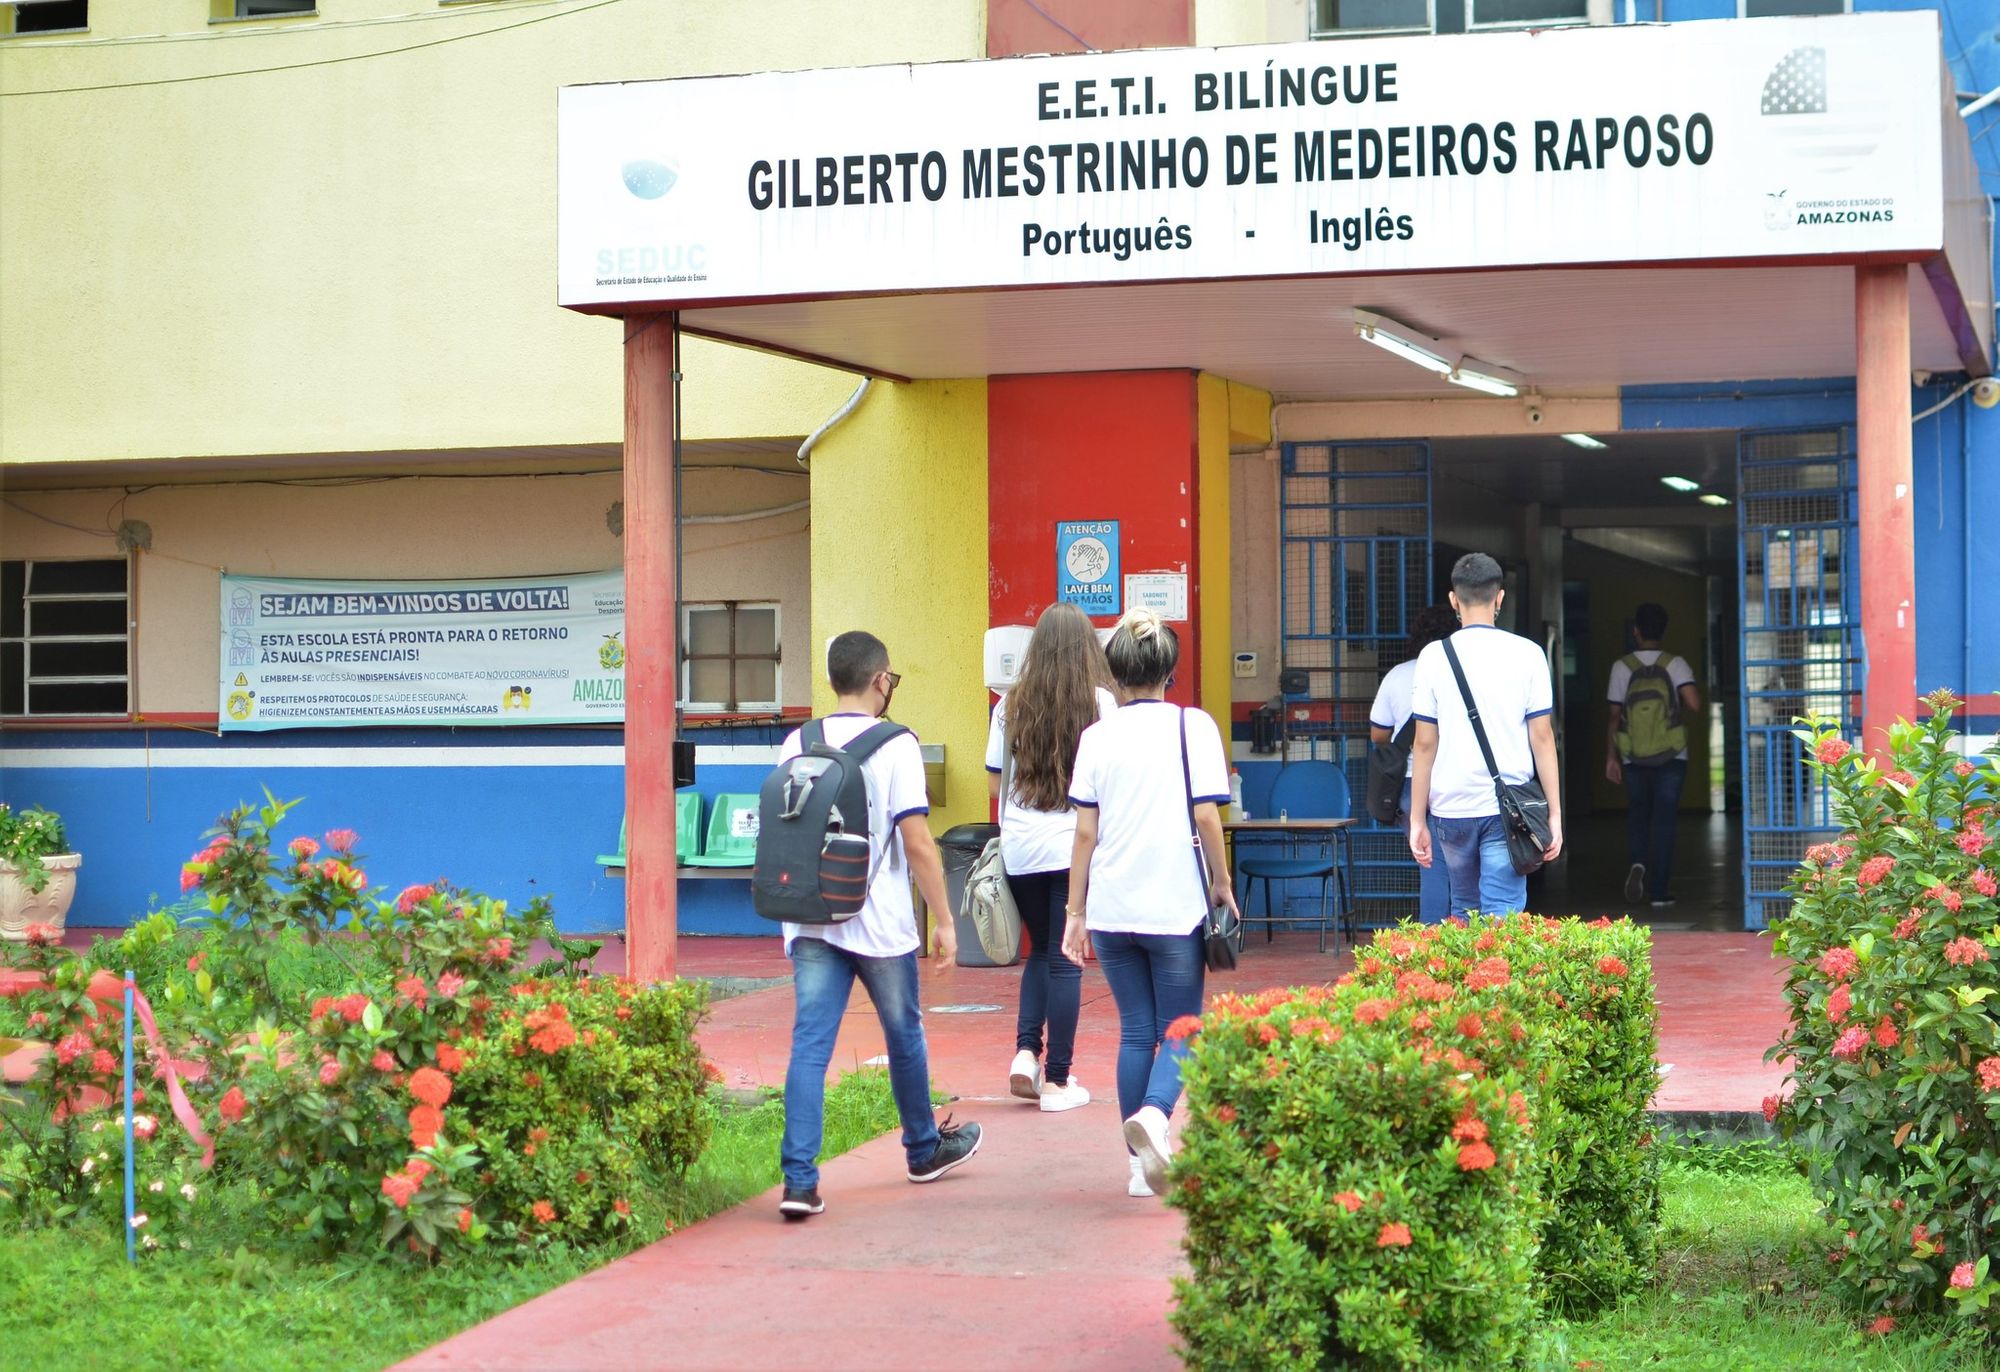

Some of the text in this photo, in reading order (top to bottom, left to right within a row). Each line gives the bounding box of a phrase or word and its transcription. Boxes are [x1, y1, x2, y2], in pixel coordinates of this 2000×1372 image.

[1038, 59, 1398, 120] E.E.T.I. BILÍNGUE
[748, 112, 1713, 211] GILBERTO MESTRINHO DE MEDEIROS RAPOSO
[1797, 210, 1894, 224] AMAZONAS
[1022, 216, 1192, 261] Português
[1310, 206, 1414, 252] Inglês
[596, 244, 706, 275] SEDUC
[596, 278, 616, 286] Secretaria
[623, 277, 636, 285] Estado
[1064, 523, 1112, 536] ATENÇÃO
[1065, 583, 1112, 594] LAVE BEM
[261, 589, 568, 616] SEJAM BEM-VINDOS DE VOLTA!
[595, 599, 624, 607] Educação
[1081, 594, 1113, 604] MÃOS
[261, 627, 568, 646] ESTA ESCOLA ESTÁ PRONTA PARA O RETORNO
[261, 648, 419, 664] ÀS AULAS PRESENCIAIS!
[261, 669, 569, 683] LEMBREM-SE: VOCÊS SÃO INDISPENSÁVEIS NO COMBATE AO NOVO CORONAVÍRUS!
[260, 695, 306, 704] RESPEITEM
[307, 695, 317, 703] OS
[319, 694, 372, 703] PROTOCOLOS
[373, 694, 383, 702] DE
[384, 692, 411, 702] SAÚDE
[418, 692, 468, 702] SEGURANÇA:
[259, 708, 307, 717] HIGIENIZEM
[308, 706, 383, 716] CONSTANTEMENTE
[384, 706, 395, 715] AS
[398, 704, 420, 715] MÃOS
[427, 705, 451, 714] USEM
[452, 704, 499, 714] MÁSCARAS
